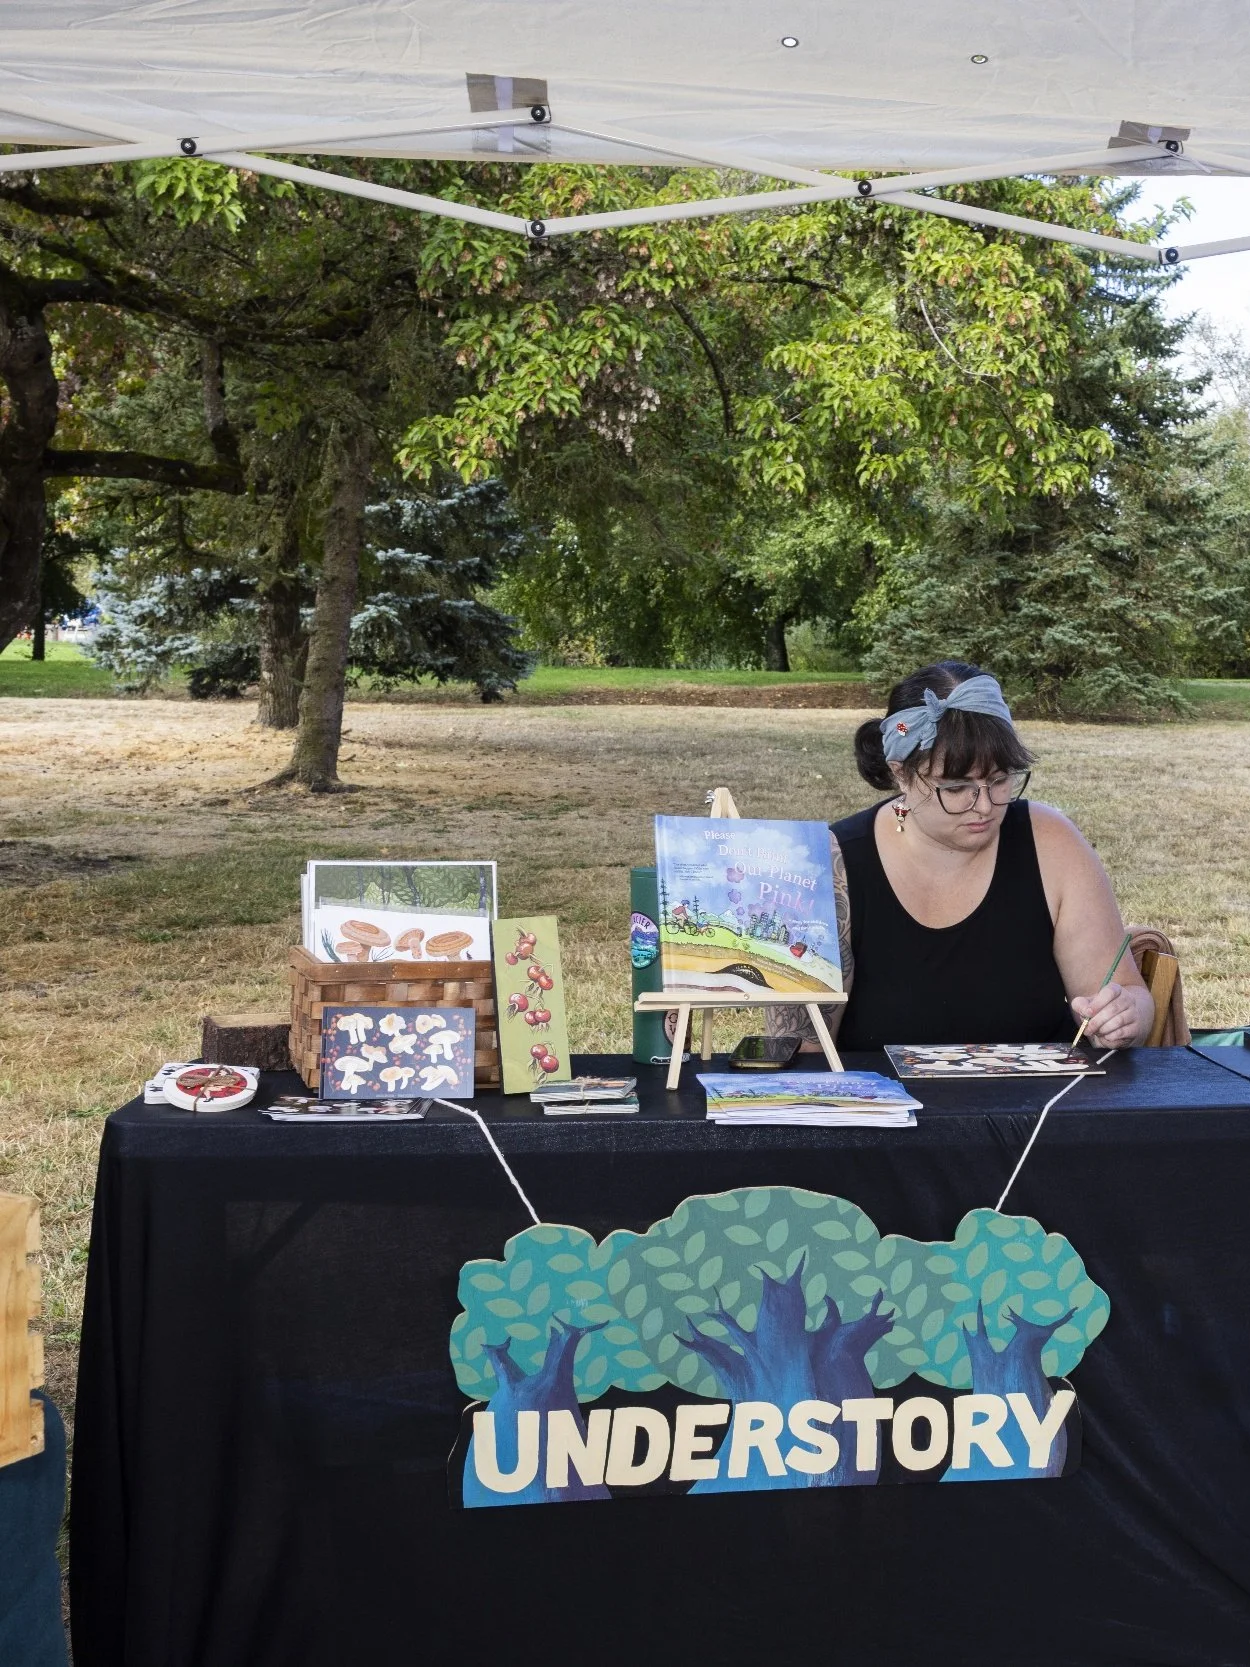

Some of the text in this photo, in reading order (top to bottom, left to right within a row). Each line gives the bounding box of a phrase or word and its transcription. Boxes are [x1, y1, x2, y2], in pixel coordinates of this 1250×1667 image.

[704, 831, 736, 840] Please
[735, 862, 761, 876] Our
[770, 866, 817, 891] Planet
[760, 882, 814, 914] Pink!
[472, 1389, 1076, 1493] UNDERSTORY
